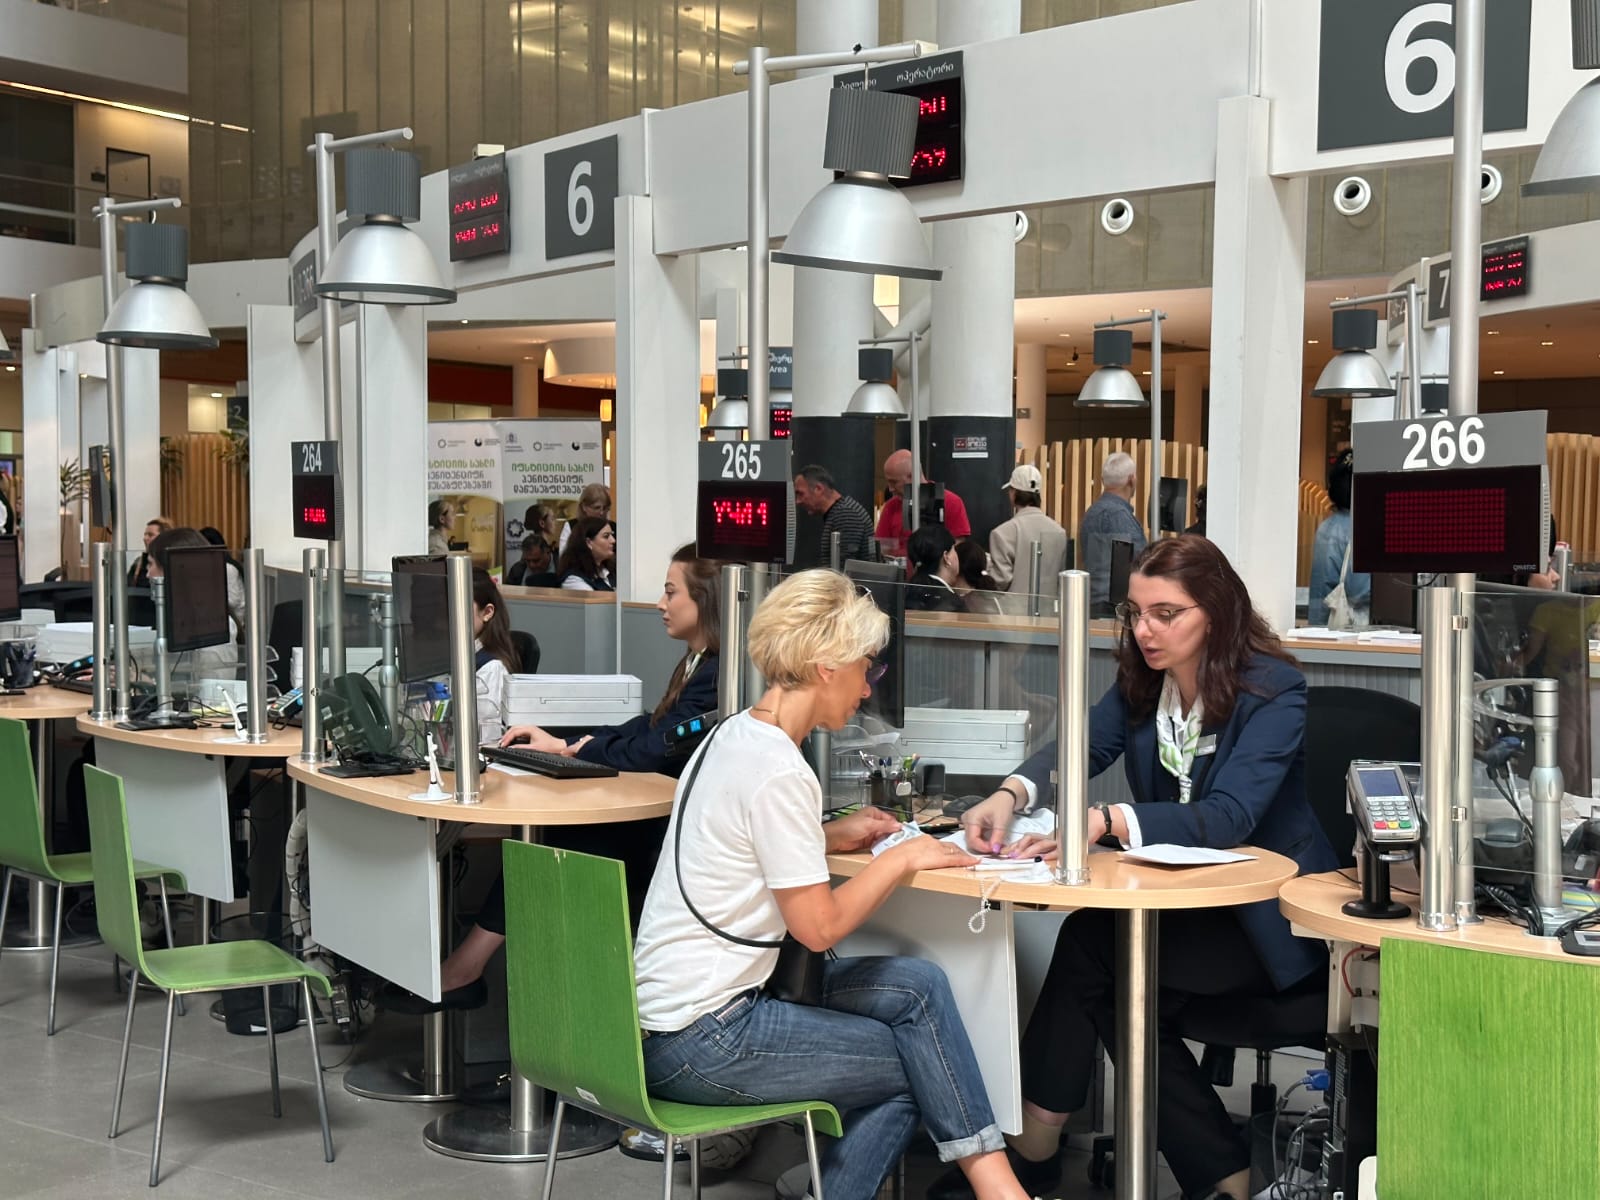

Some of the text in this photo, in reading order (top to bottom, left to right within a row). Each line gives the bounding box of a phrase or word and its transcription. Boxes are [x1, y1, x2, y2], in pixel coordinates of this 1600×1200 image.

[896, 61, 954, 83] ოპერატორი
[1385, 2, 1456, 114] 6
[567, 160, 595, 237] 6
[1439, 268, 1451, 309] 7
[769, 366, 788, 374] Area
[302, 442, 322, 473] 264
[721, 443, 761, 480] 265
[1402, 416, 1486, 470] 266
